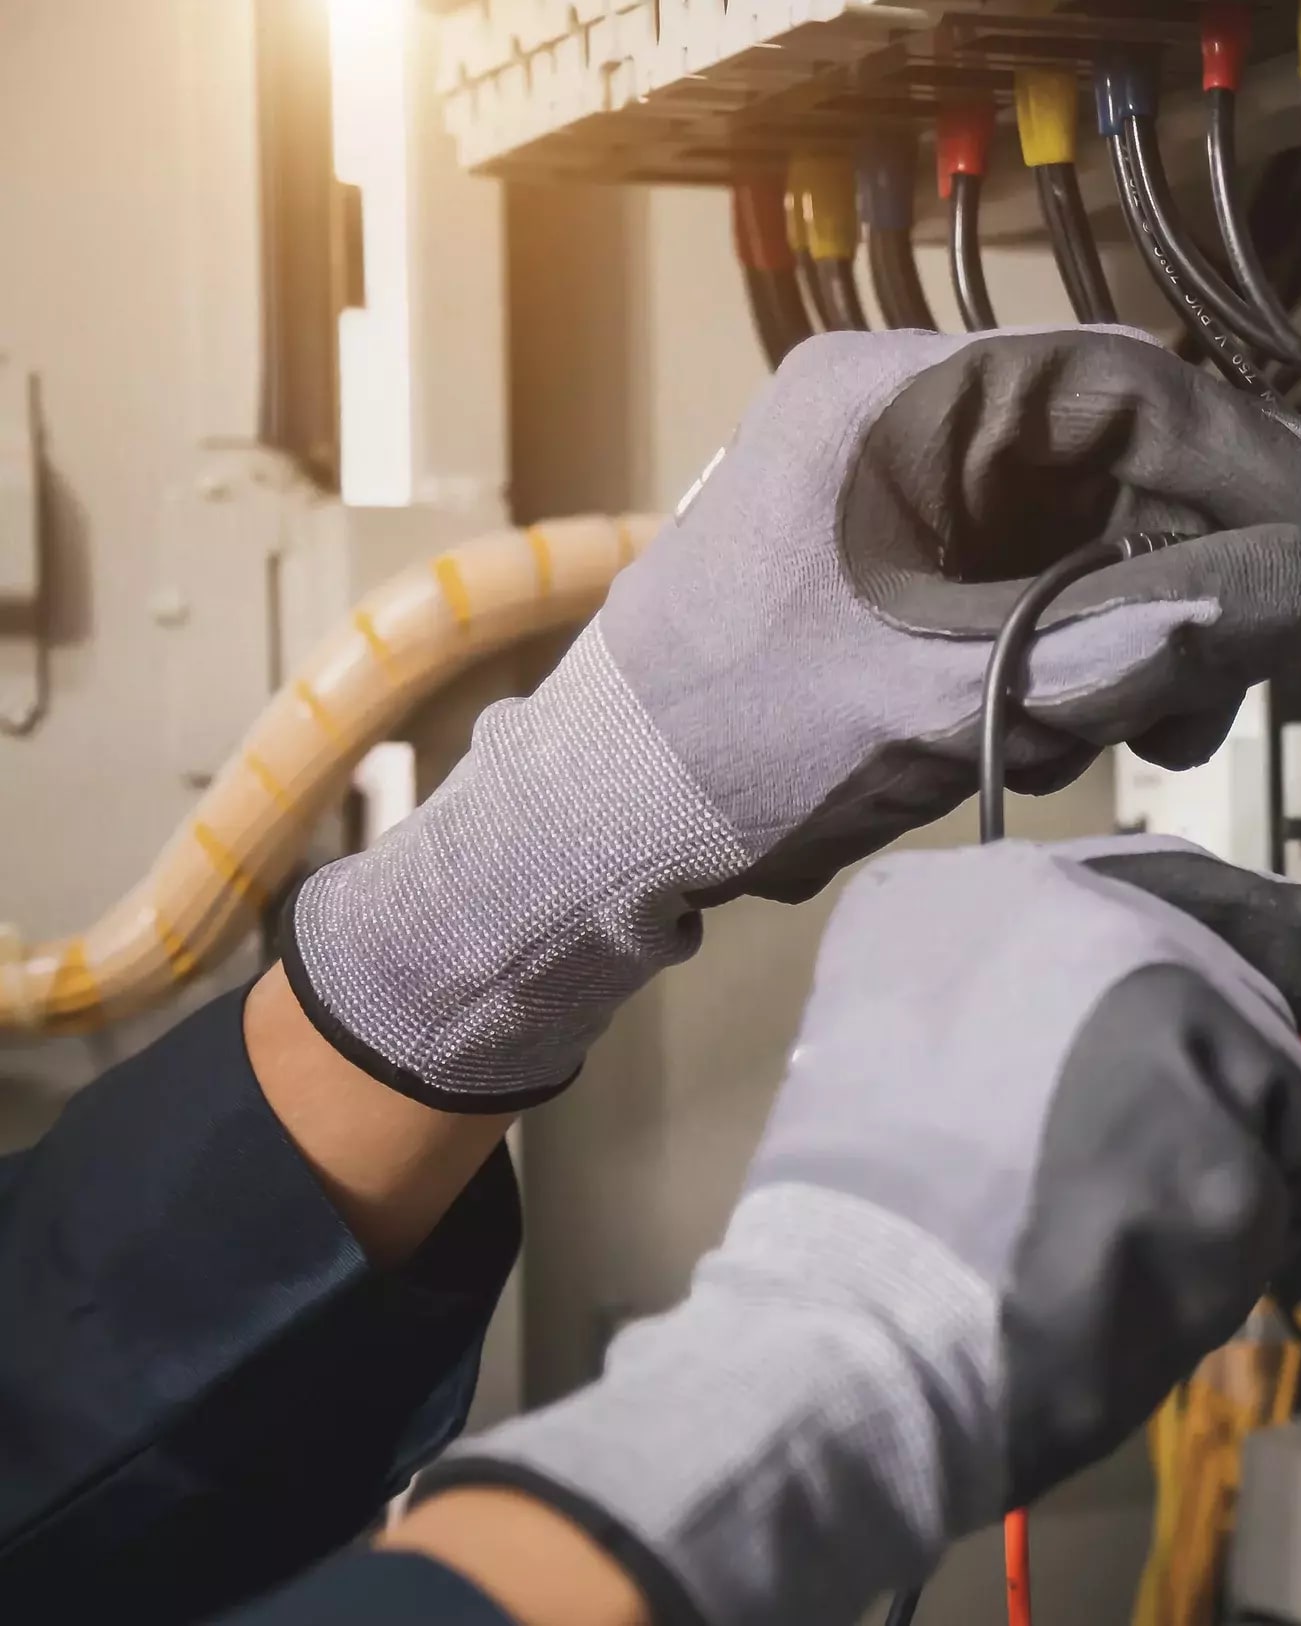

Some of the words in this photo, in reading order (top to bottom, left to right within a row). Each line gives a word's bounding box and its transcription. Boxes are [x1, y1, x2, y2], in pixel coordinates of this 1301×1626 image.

[1185, 294, 1210, 327] PVC
[1215, 335, 1227, 348] V
[1232, 354, 1255, 384] 750
